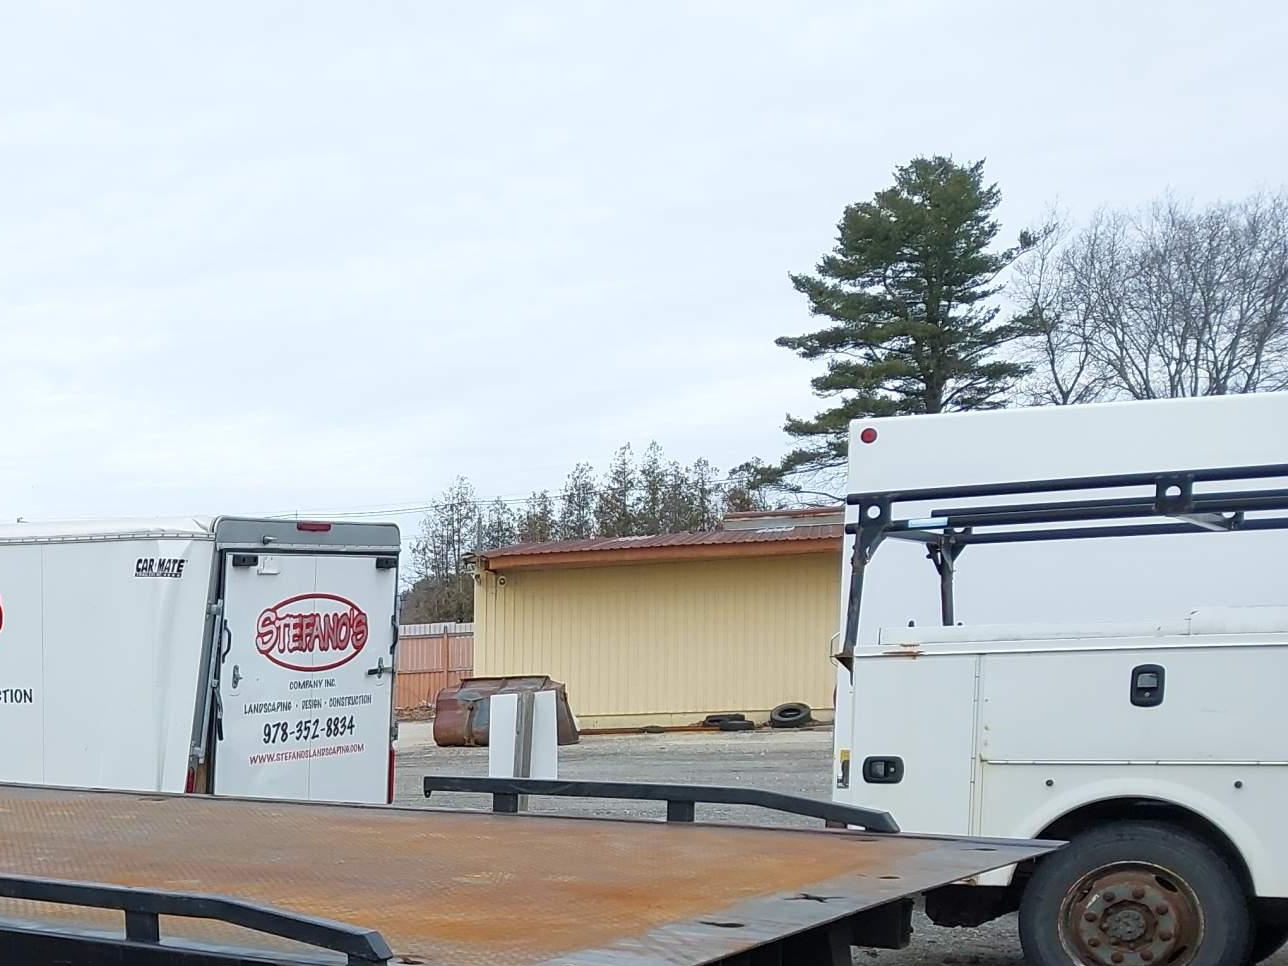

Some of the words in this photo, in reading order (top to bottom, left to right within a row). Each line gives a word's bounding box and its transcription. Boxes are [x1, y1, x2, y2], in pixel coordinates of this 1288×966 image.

[136, 558, 154, 572] CAR
[157, 558, 185, 572] MATE
[256, 607, 368, 654] STEFANO'S
[289, 680, 323, 690] COMPANY
[244, 702, 292, 715] LANDSCAPING
[301, 699, 322, 710] DESIGN
[328, 694, 372, 708] CONSTRUCTION
[262, 715, 355, 744] 978-352-8834
